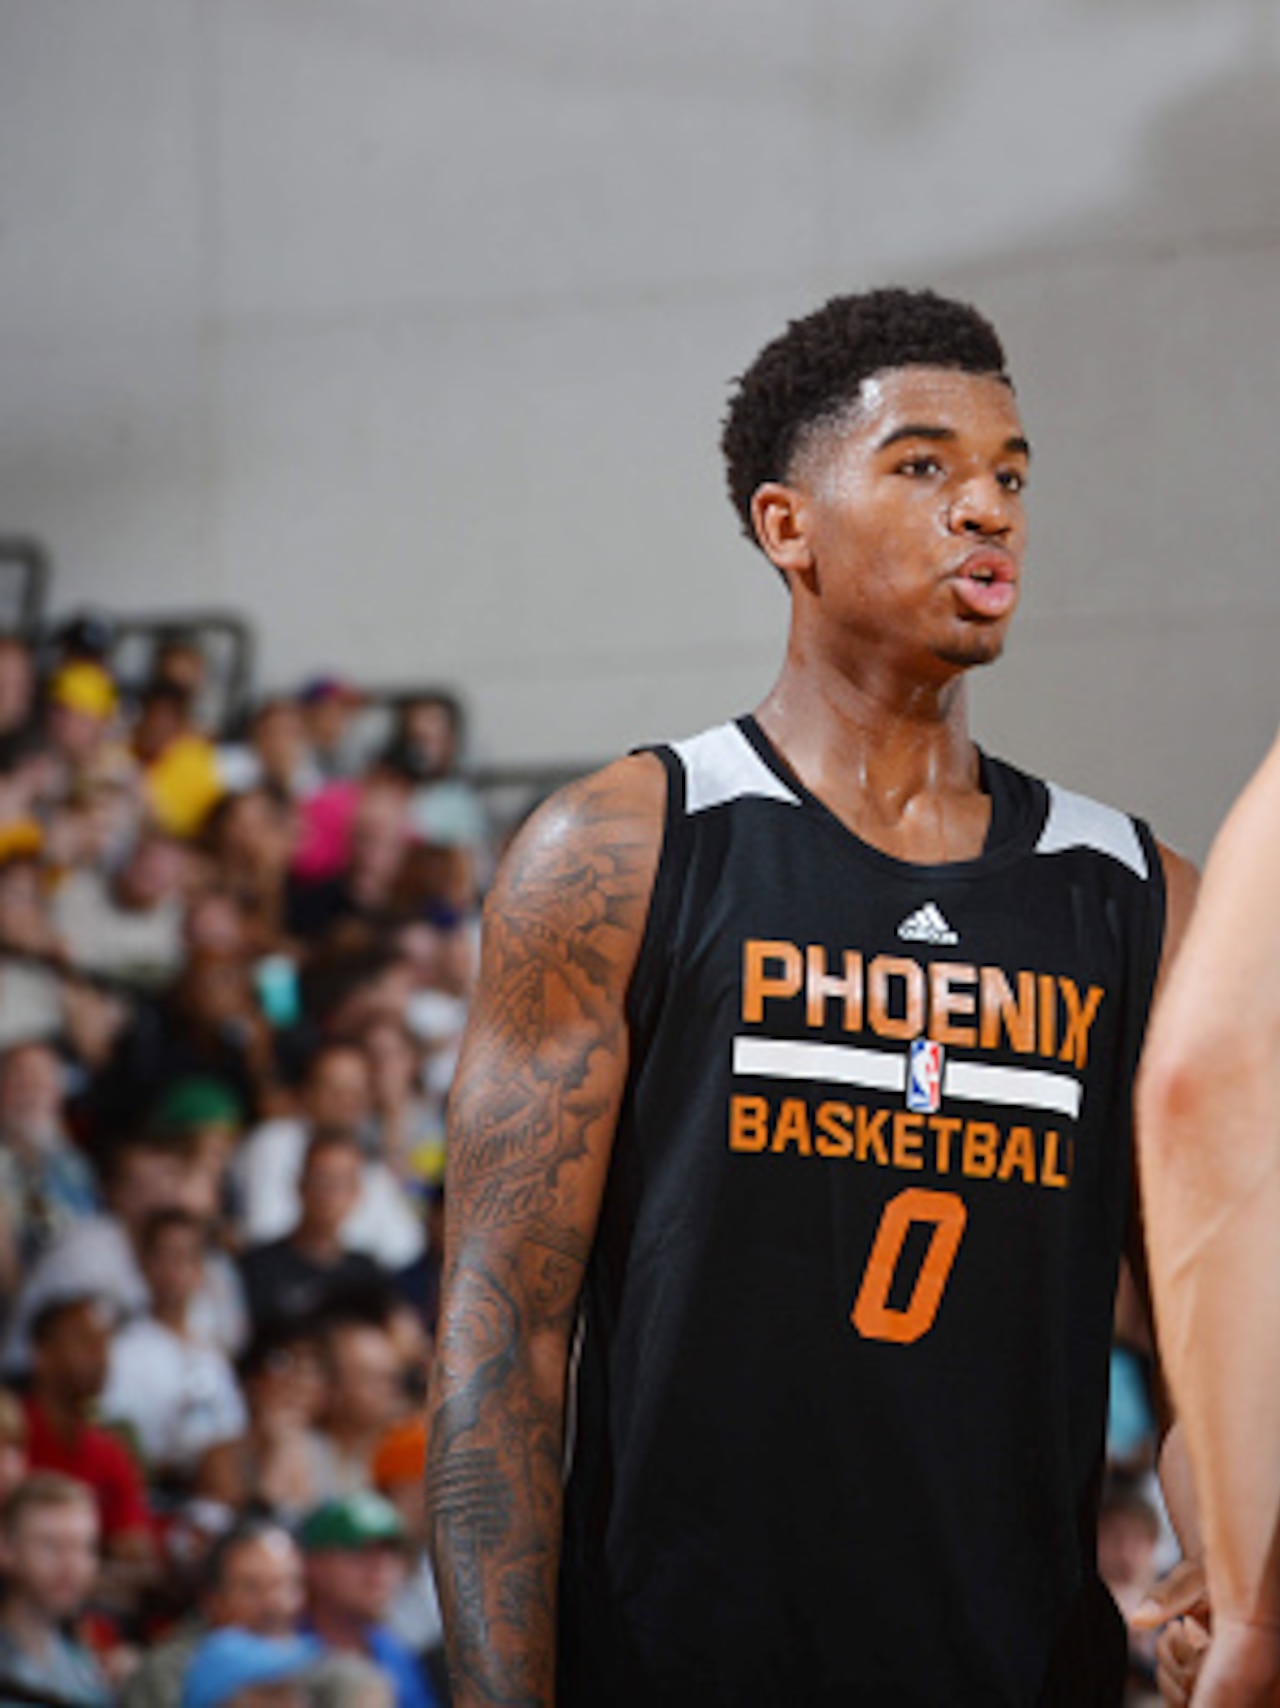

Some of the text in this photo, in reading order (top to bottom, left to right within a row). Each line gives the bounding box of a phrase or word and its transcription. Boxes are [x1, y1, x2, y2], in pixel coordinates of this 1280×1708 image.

[741, 938, 1105, 1069] PHOENIX
[728, 1094, 1075, 1188] BASKETBAL
[850, 1187, 968, 1344] 0
